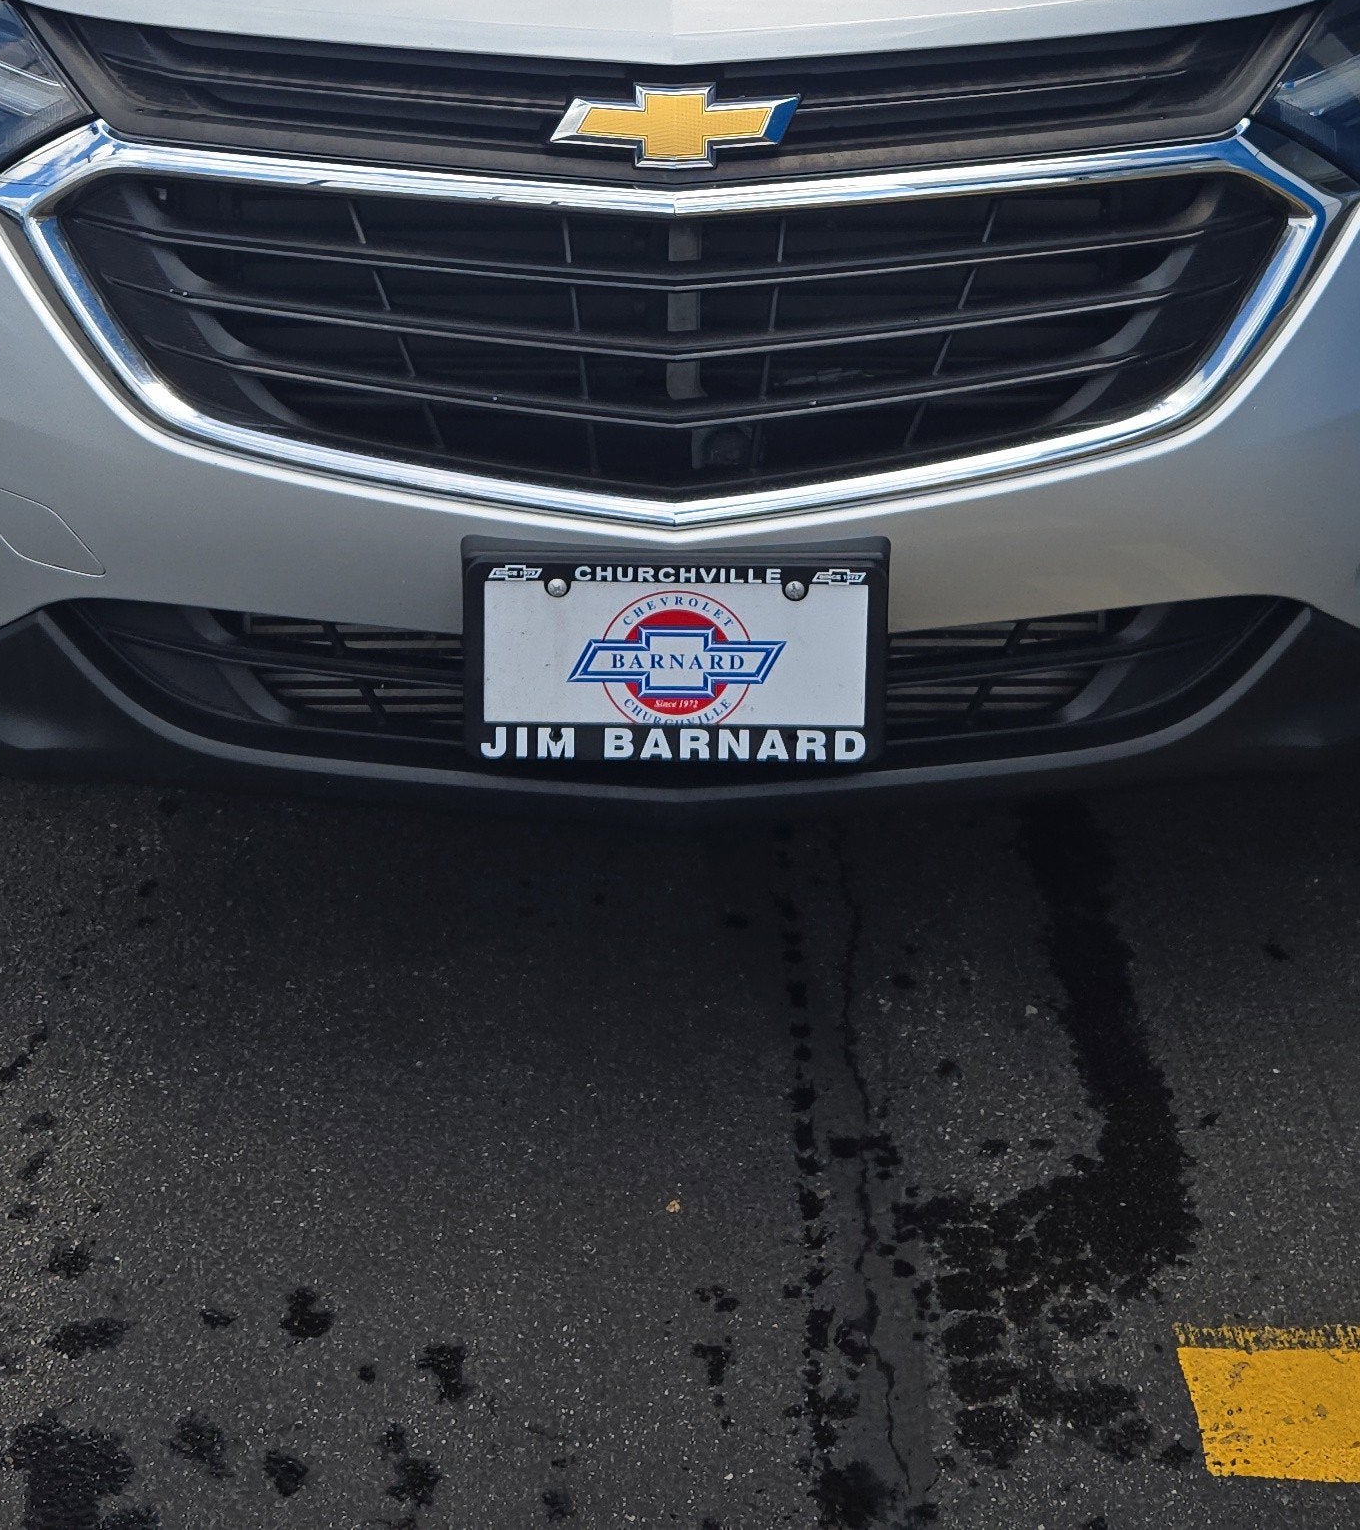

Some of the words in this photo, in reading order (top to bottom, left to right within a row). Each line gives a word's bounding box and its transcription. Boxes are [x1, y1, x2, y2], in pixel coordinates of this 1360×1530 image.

[574, 565, 782, 585] CHURCHVILLE
[623, 596, 734, 627] CHEVROLET
[611, 653, 745, 670] BARNARD
[654, 699, 677, 708] Since
[678, 699, 699, 709] 1972
[481, 726, 575, 759] JIM
[604, 728, 867, 761] BARNARD
